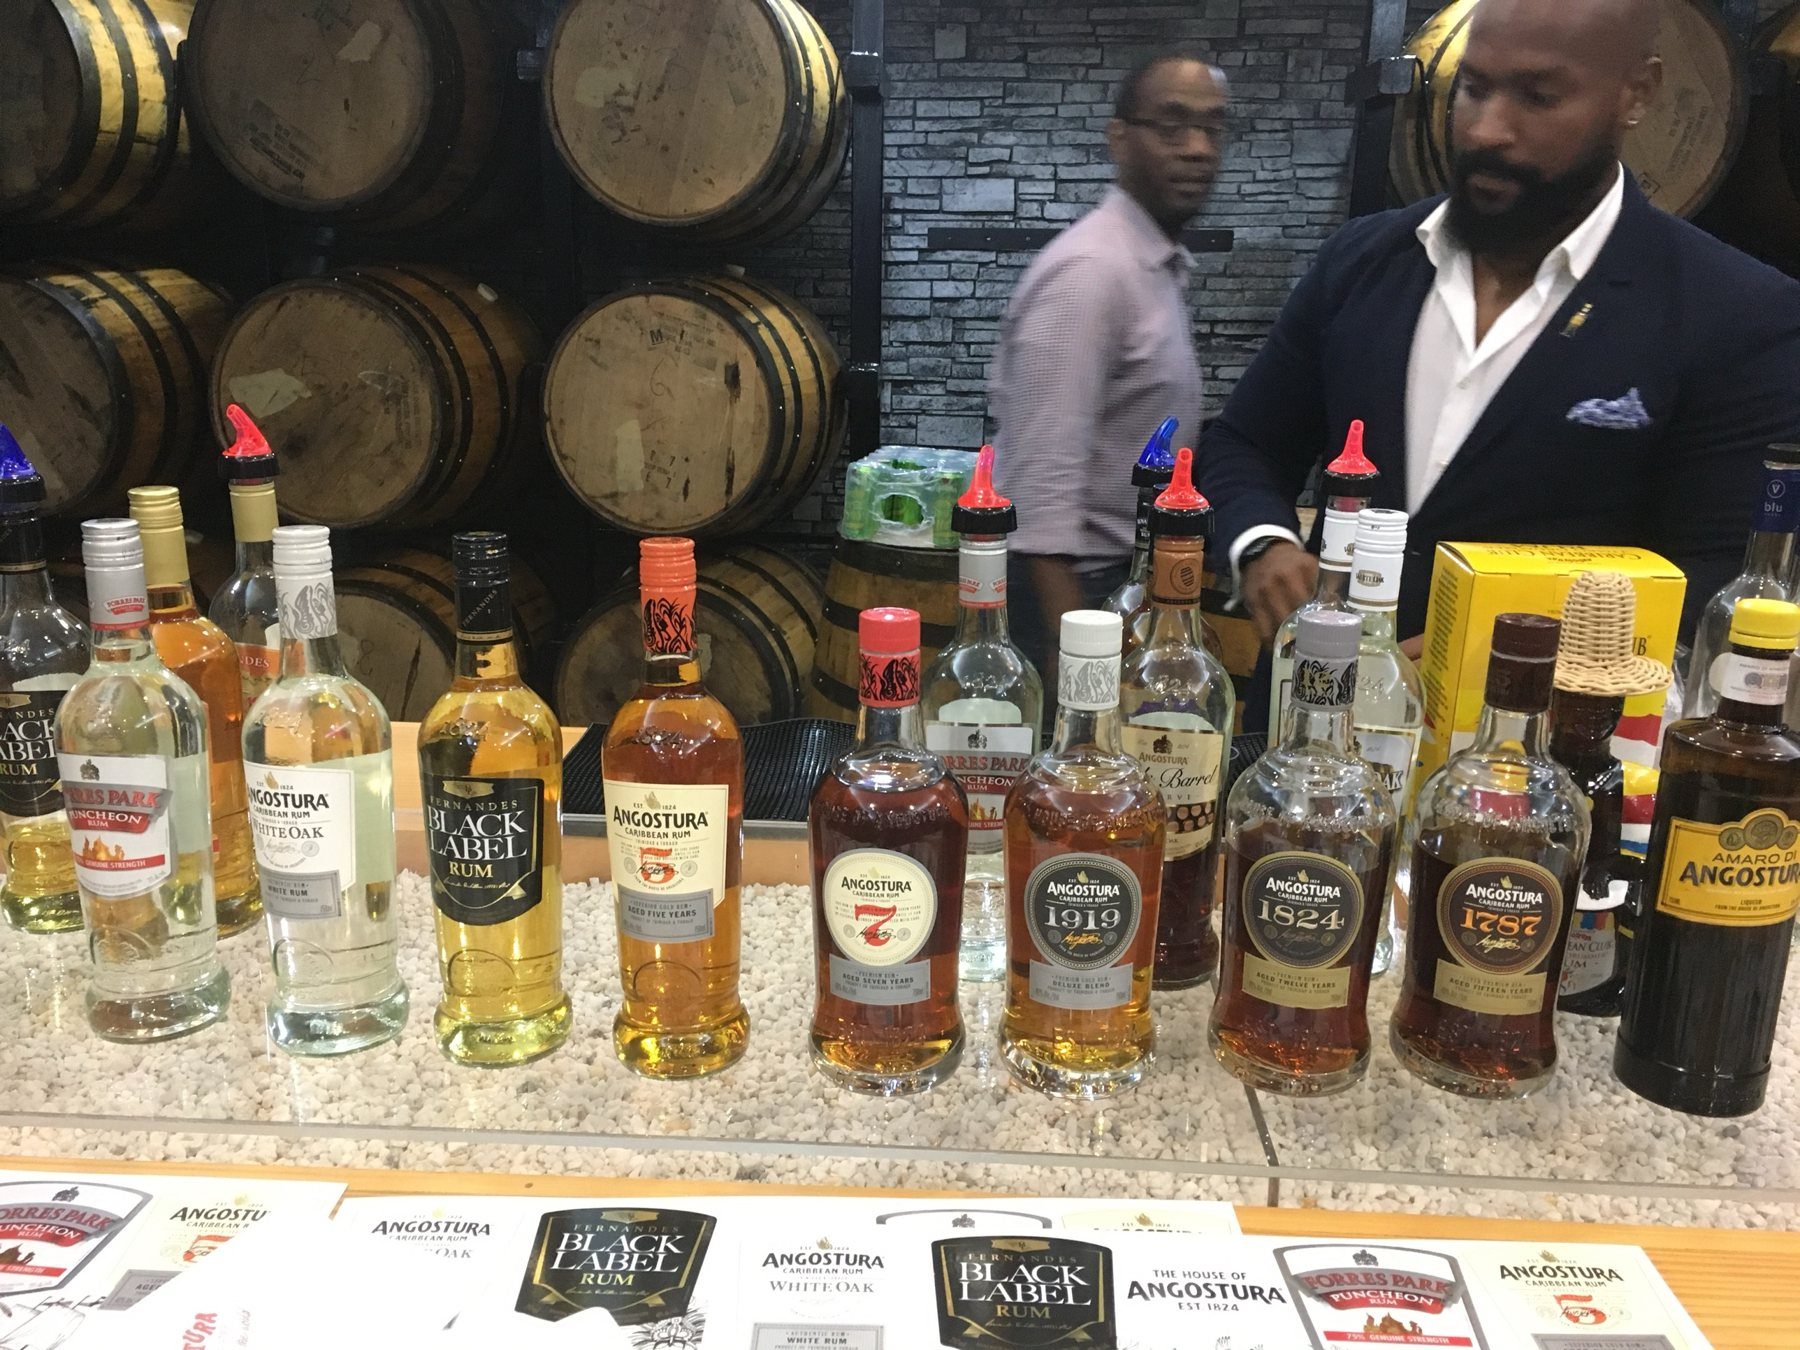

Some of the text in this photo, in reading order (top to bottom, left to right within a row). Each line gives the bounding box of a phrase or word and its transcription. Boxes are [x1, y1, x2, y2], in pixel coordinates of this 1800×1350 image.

[0, 719, 54, 740] ACK
[0, 739, 57, 760] ABEL
[943, 755, 988, 770] RRES
[1140, 752, 1188, 765] ANGOSTURA
[0, 763, 38, 775] RUM
[1159, 765, 1218, 788] Barrel
[957, 776, 1014, 786] NCHEON
[108, 789, 161, 808] PARK
[430, 795, 518, 812] FERNANDES
[70, 810, 142, 825] PUNCHEON
[253, 805, 310, 820] CARIBBEAN RUM
[613, 805, 709, 830] ANGOSTURA
[88, 820, 109, 828] RUM
[253, 819, 287, 838] WHITE
[288, 826, 324, 840] OAK
[427, 805, 528, 838] BLACK
[625, 827, 691, 840] CARIBBEAN RUM
[429, 828, 528, 861] LABEL
[111, 860, 146, 868] STRENGTH
[640, 847, 676, 884] 5
[1712, 850, 1797, 865] AMARO DI
[449, 861, 494, 878] RUM
[1680, 861, 1800, 887] ANGOSTUR
[841, 876, 912, 893] ANGOSTURA
[1047, 881, 1120, 897] ANGOSTURA
[1266, 877, 1341, 898] ANGOSTURA
[290, 889, 308, 897] RUM
[852, 890, 884, 898] CARIBBEAN
[1059, 895, 1093, 903] CARIBBEAN
[1278, 891, 1312, 902] CARIBBEAN
[1466, 883, 1543, 904] ANGOSTURA
[1479, 898, 1515, 909] CARIBBEAN
[628, 905, 645, 916] AGED
[648, 910, 666, 918] FIVE
[669, 909, 697, 919] YEARS
[1044, 905, 1121, 930] 1919
[1257, 899, 1345, 930] 1824
[854, 903, 897, 946] 7
[1460, 907, 1542, 936] 1787
[843, 973, 860, 982] AGED
[890, 977, 913, 985] YEARS
[1052, 980, 1081, 989] DELUXE
[1257, 972, 1275, 982] AGED
[1279, 979, 1308, 988] TWELVE
[1450, 977, 1470, 987] AGED
[1474, 985, 1506, 994] FIFTEEN
[0, 1206, 113, 1230] ORRES PARK
[170, 1207, 268, 1221] ANGOSTU
[0, 1223, 80, 1239] UNCHEON
[372, 1221, 490, 1236] ANGOSTURA
[573, 1224, 679, 1233] FERNANDES
[556, 1233, 686, 1254] BLACK
[550, 1251, 679, 1272] LABEL
[762, 1252, 884, 1269] ANGOSTURA
[968, 1253, 1077, 1264] FERNANDES
[580, 1273, 634, 1286] RUM
[959, 1262, 1091, 1286] BLACK
[1153, 1269, 1247, 1280] THE HOUSE OF
[1500, 1264, 1624, 1282] ANGOSTURA
[770, 1281, 874, 1293] WHITE OAK
[1302, 1272, 1453, 1294] FORRES PARK
[1525, 1280, 1582, 1288] CARIBBEAN
[959, 1281, 1092, 1305] LABEL
[1127, 1280, 1287, 1304] ANGOSTURA
[1330, 1290, 1434, 1305] PUNCHEON
[996, 1304, 1051, 1319] RUM
[1178, 1302, 1239, 1311] EST 1824
[1553, 1294, 1607, 1325] 5
[1369, 1334, 1406, 1342] GENUINE
[1407, 1335, 1450, 1344] STRENGTH
